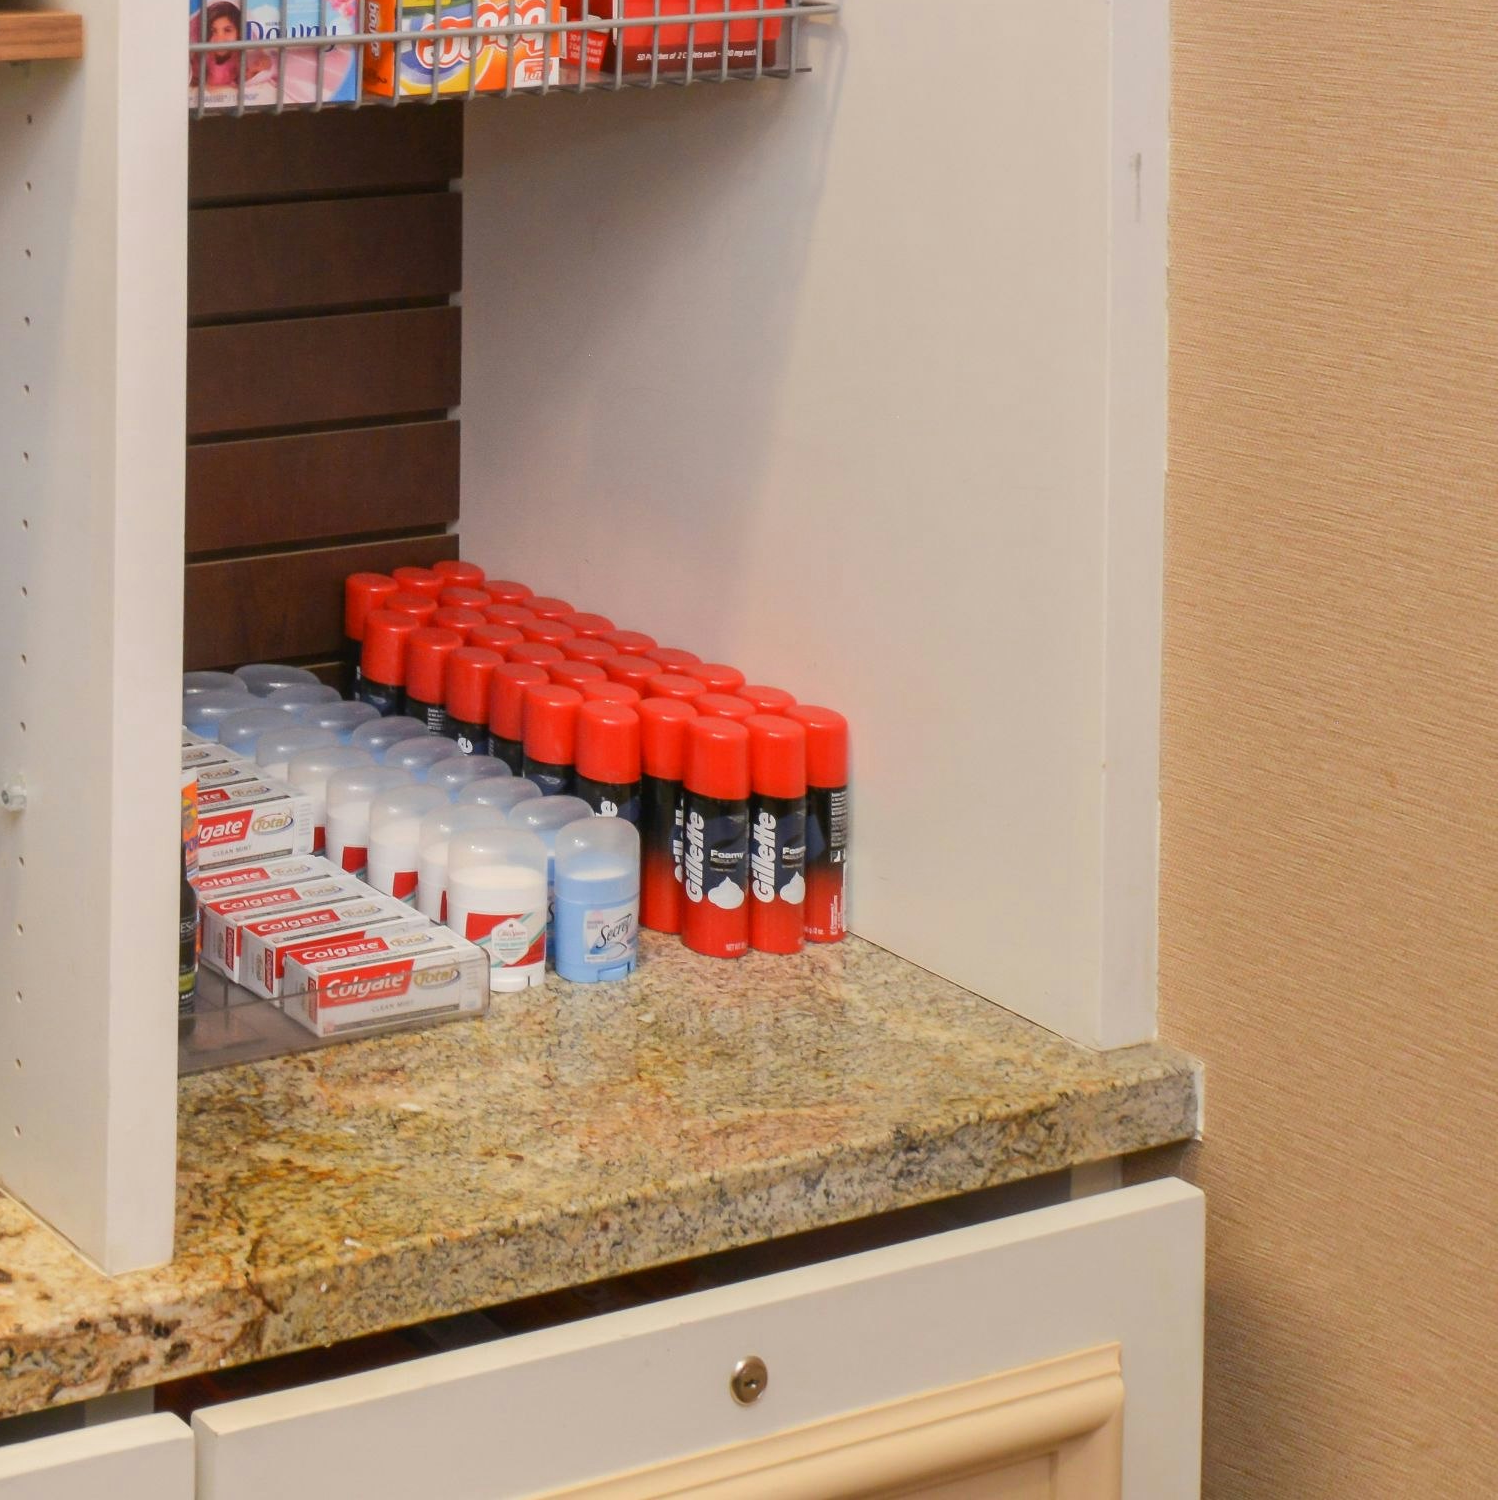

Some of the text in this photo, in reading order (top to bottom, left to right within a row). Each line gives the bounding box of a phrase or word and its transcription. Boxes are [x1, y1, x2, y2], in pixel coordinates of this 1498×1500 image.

[246, 20, 337, 52] Downy
[199, 814, 288, 843] lgate Total
[686, 811, 704, 903] Gillette
[710, 850, 744, 860] Foamy
[752, 811, 777, 903] Gillette
[219, 892, 291, 911] Colgate
[257, 913, 331, 933] Colgate
[596, 913, 632, 948] Secret
[301, 941, 379, 960] Colgate
[414, 970, 454, 988] Total
